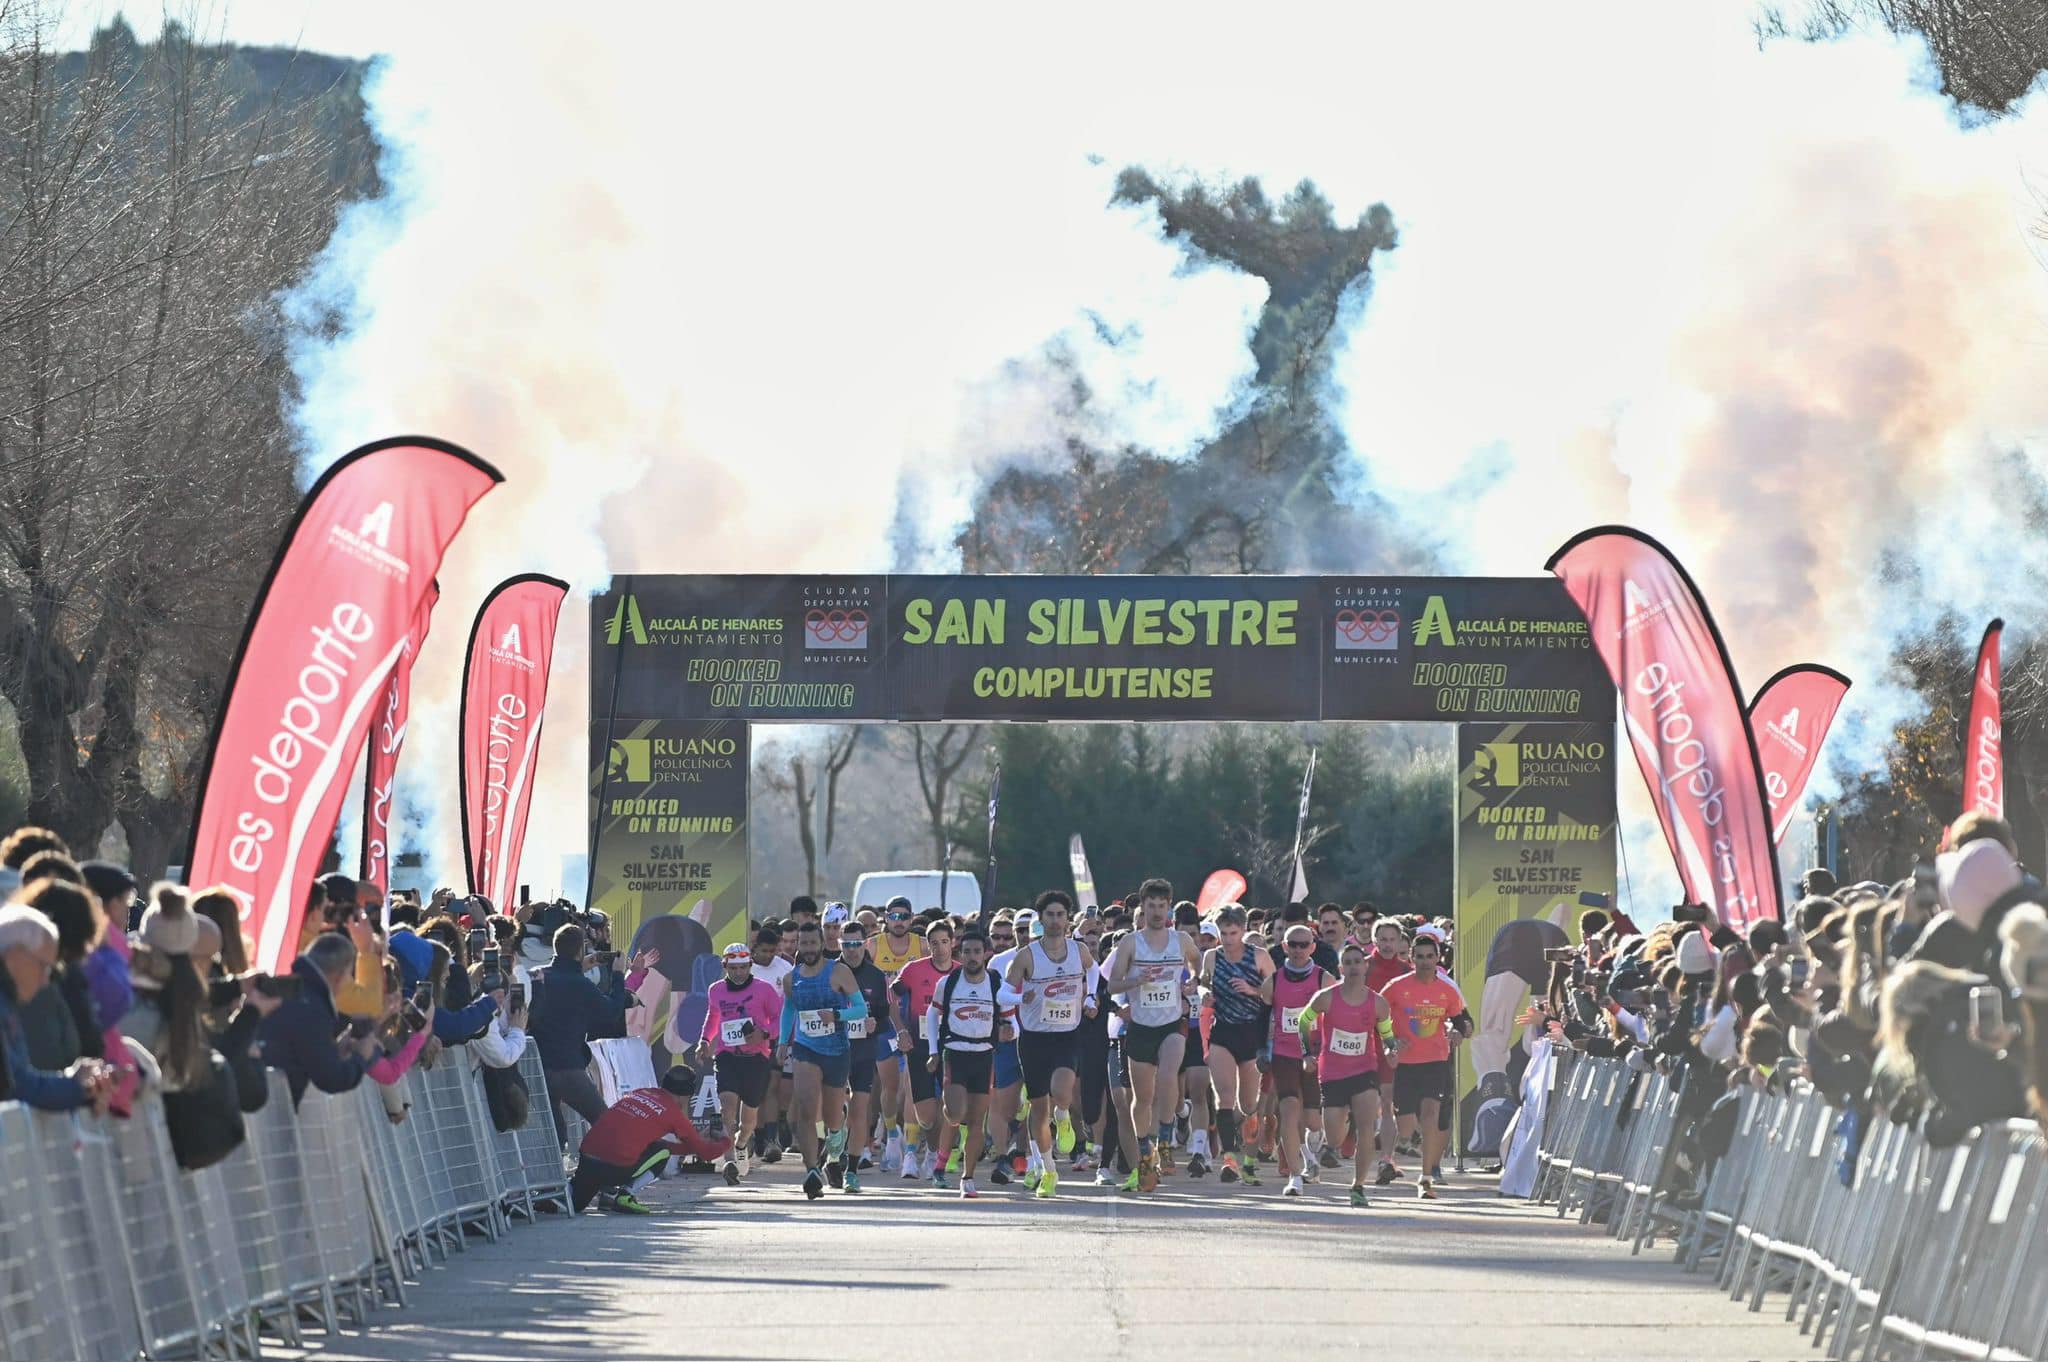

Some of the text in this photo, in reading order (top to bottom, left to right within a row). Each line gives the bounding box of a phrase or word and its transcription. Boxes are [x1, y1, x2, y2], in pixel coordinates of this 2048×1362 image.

[804, 587, 871, 596] CIUDAD
[1335, 587, 1401, 595] CIUDAD
[804, 599, 870, 607] DEPORTIVA
[1335, 599, 1400, 607] DEPORTIVA
[649, 616, 783, 631] ALCALÁ DE HENARES
[903, 598, 1298, 645] SAN SILVESTRE
[1456, 618, 1505, 633] ALCALÁ
[1510, 621, 1527, 633] DE
[649, 634, 783, 646] AYUNTAMIENTO
[1456, 636, 1590, 648] AYUNTAMIENTO
[804, 655, 869, 663] MUNICIPAL
[1334, 655, 1399, 664] MUNICIPAL
[687, 659, 781, 682] HOOKED
[1413, 663, 1507, 686] HOOKED
[973, 667, 1213, 698] COMPLUTENSE
[252, 601, 374, 802] deporte
[710, 683, 854, 707] ON RUNNING
[1436, 688, 1581, 713] ON RUNNING
[654, 739, 736, 755] RUANO
[1522, 742, 1604, 760] RUANO
[654, 757, 732, 769] POLICLÍNICA
[1522, 761, 1601, 773] POLICLÍNICA
[654, 772, 702, 782] DENTAL
[1522, 776, 1570, 786] DENTAL
[611, 799, 680, 815] HOOKED
[1478, 807, 1546, 823] HOOKED
[629, 817, 734, 833] ON RUNNING
[1495, 825, 1600, 841] ON RUNNING
[229, 811, 275, 874] es
[650, 845, 684, 860] SAN
[1520, 849, 1554, 863] SAN
[622, 863, 712, 879] SILVESTRE
[1493, 867, 1582, 882] SILVESTRE
[627, 881, 707, 891] COMPLUTENSE
[1497, 885, 1577, 895] COMPLUTENSE
[1148, 992, 1171, 1002] 1157
[1048, 1009, 1071, 1019] 1158
[727, 1031, 743, 1040] 130
[1337, 1039, 1361, 1050] 1680
